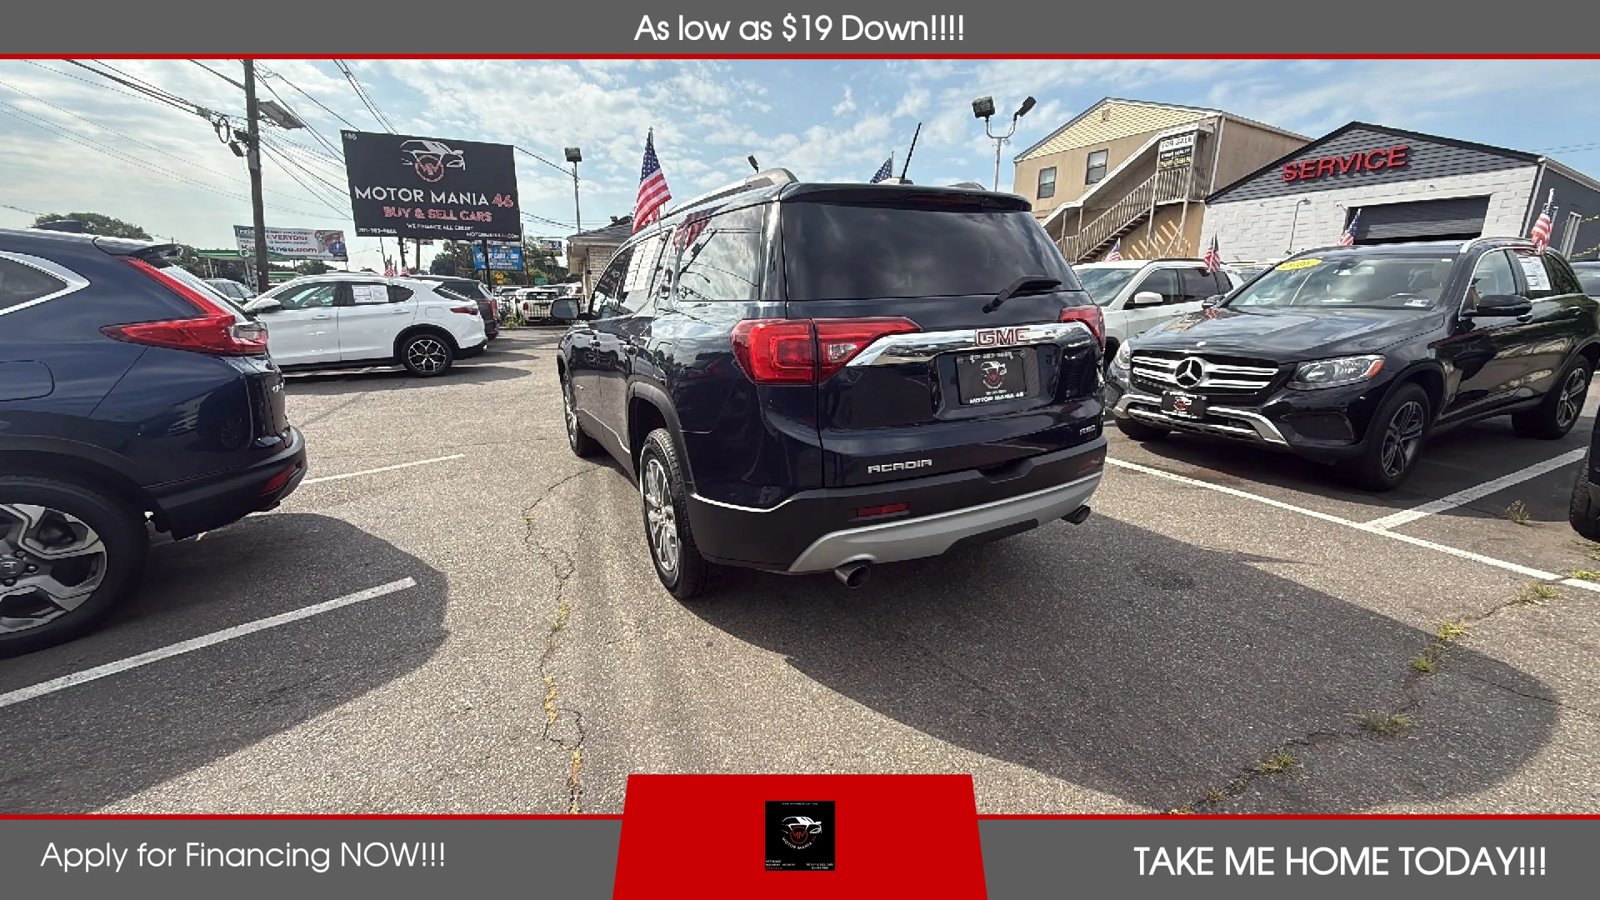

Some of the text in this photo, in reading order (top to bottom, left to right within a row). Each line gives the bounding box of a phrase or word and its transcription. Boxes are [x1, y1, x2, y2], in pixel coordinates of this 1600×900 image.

[1282, 145, 1409, 183] SERVICE
[354, 186, 514, 208] MOTOR MANIA 46
[382, 206, 493, 223] BUY & SELL CARS
[266, 233, 309, 242] EVERYONE
[977, 327, 1031, 346] GMC
[969, 395, 994, 404] MOTOR
[867, 458, 933, 474] ACADIA
